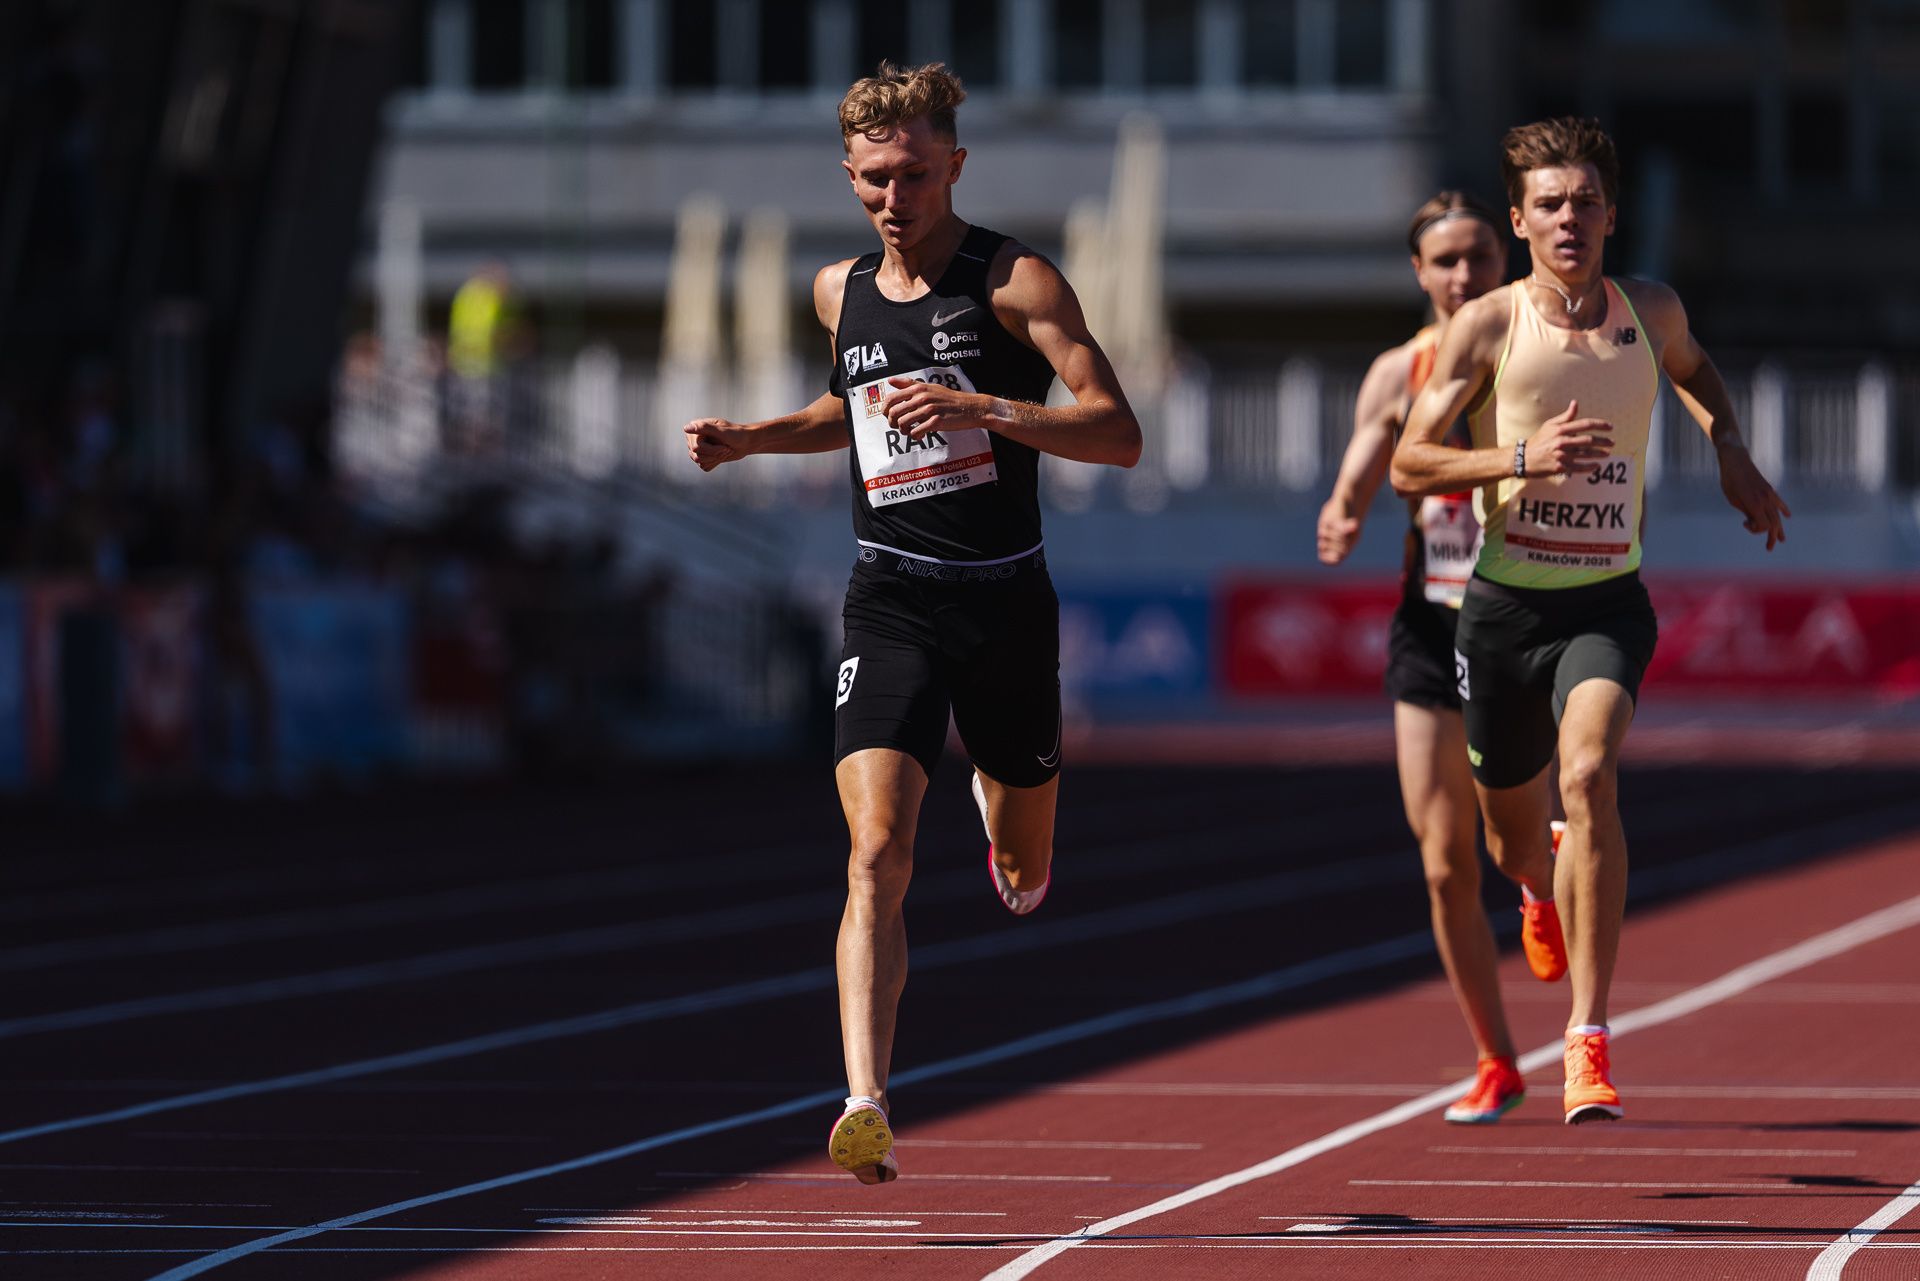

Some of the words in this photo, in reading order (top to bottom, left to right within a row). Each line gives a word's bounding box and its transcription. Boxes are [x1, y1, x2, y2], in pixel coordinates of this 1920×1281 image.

[950, 334, 978, 343] OPOLE
[861, 342, 888, 368] LA
[939, 349, 981, 360] OPOLSKIE
[866, 404, 882, 416] MZL
[878, 477, 896, 486] PZLA
[896, 467, 942, 482] Mistrzostwa
[943, 462, 966, 472] Polski
[967, 456, 981, 466] U23
[1586, 461, 1627, 485] 342
[882, 481, 936, 501] KRAKÓW
[940, 473, 970, 489] 2025
[1519, 498, 1625, 529] HERZYK
[896, 558, 960, 582] NIKE
[962, 562, 1017, 582] PRO
[1527, 550, 1582, 566] KRAKÓW
[1583, 555, 1612, 567] 2025
[838, 666, 853, 698] 3
